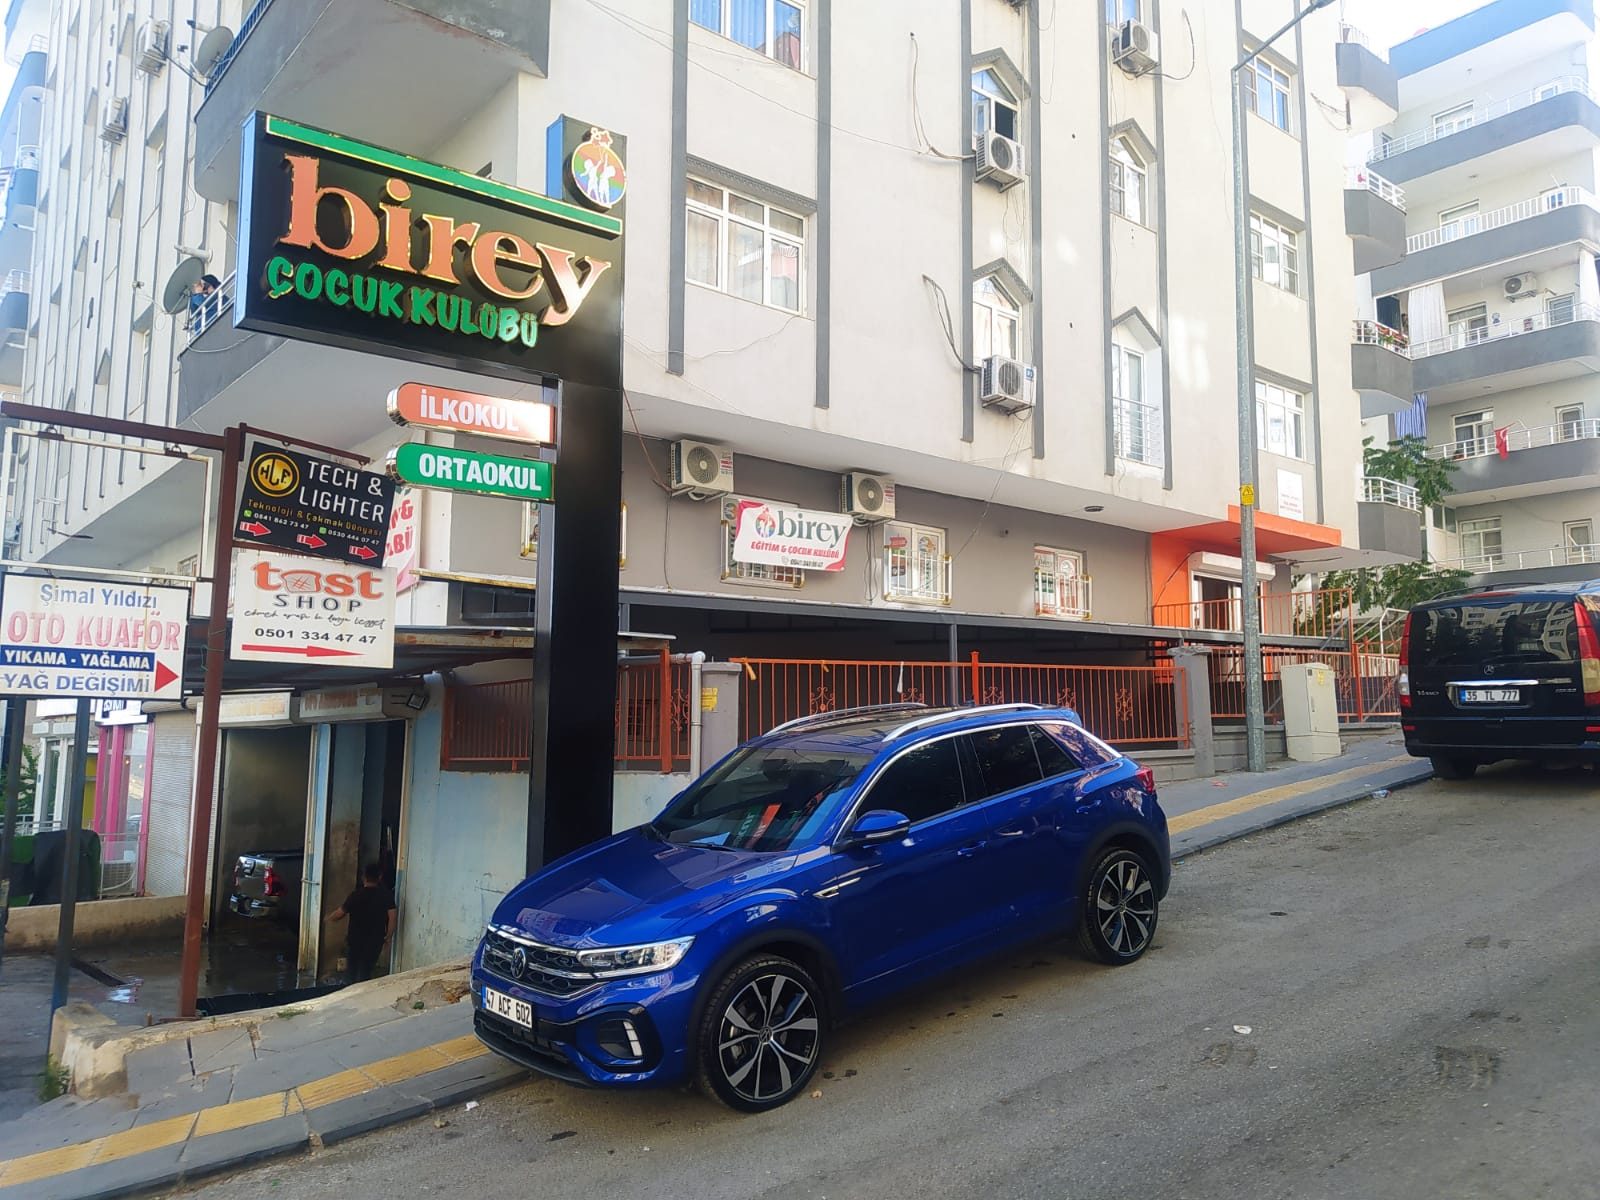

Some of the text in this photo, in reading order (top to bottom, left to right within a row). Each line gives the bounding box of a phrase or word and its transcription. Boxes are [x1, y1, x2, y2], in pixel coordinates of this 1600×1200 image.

[280, 153, 612, 326] birey
[267, 255, 539, 348] ÇOCUK KULÜBÜ
[420, 388, 519, 432] İLKOKUL
[308, 460, 384, 497] TECH &
[419, 453, 542, 491] ORTAOKUL
[248, 499, 294, 517] Teknoloji
[296, 510, 304, 519] &
[306, 513, 343, 529] Çakmak
[299, 485, 385, 524] LIGHTER
[300, 522, 310, 530] 47
[777, 510, 847, 549] birey
[750, 540, 780, 553] EĞİTİM
[788, 545, 813, 557] ÇOCUK
[40, 583, 157, 609] Şimal Yıldızı
[273, 594, 362, 612] SHOP
[7, 610, 182, 651] OTO KUAFÖR
[254, 627, 377, 645] 0501 334 47 47
[3, 649, 68, 667] YIKAMA
[80, 652, 151, 669] YAĞLAMA
[3, 670, 151, 696] YAĞ DEĞİŞİMİ
[1466, 690, 1518, 702] 35 TL 777
[486, 988, 495, 1009] 47
[498, 995, 512, 1017] ACF
